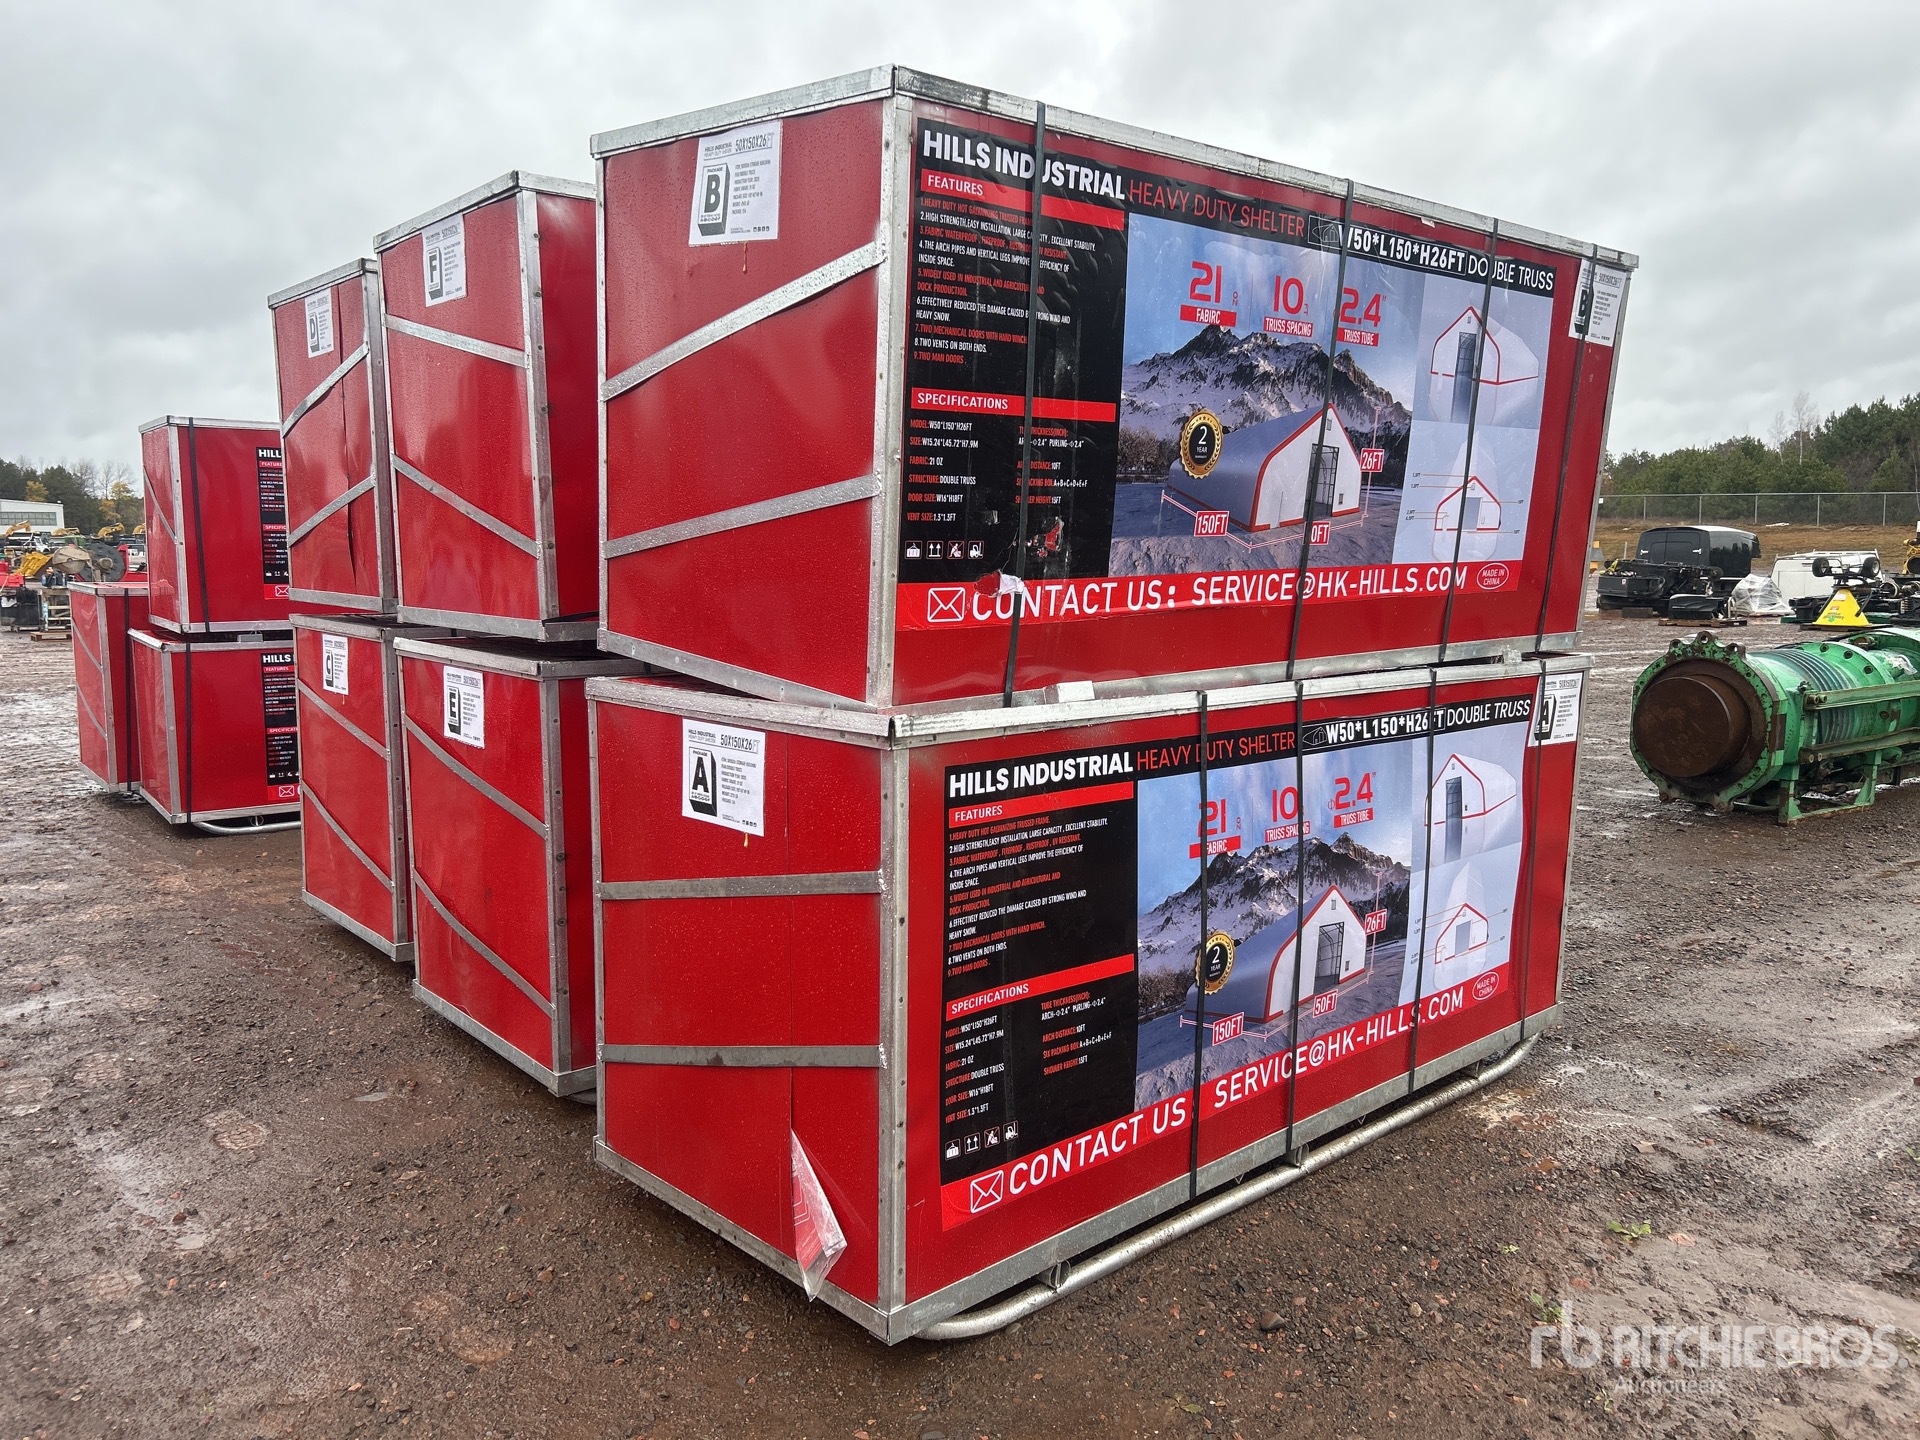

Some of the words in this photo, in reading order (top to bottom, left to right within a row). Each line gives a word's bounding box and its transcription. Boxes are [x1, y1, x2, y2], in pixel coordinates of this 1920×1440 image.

[704, 174, 721, 213] B
[928, 174, 983, 196] FEATURES
[923, 130, 991, 169] HILLS
[1129, 179, 1189, 212] HEAVY
[1194, 194, 1237, 222] DUTY
[1240, 205, 1305, 237] SHELTER
[1518, 265, 1554, 291] TRUSS
[920, 211, 938, 222] 2.HIGH
[1012, 228, 1026, 238] LARGE
[1052, 236, 1074, 248] EXCELLENT
[918, 254, 936, 263] INSIDE
[936, 242, 950, 252] ARCH
[951, 244, 966, 254] PIPES
[966, 247, 976, 256] AND
[978, 248, 998, 260] VERTICAL
[1000, 252, 1010, 262] LEGS
[1064, 264, 1070, 272] OF
[429, 254, 437, 284] F
[1189, 261, 1222, 303] 21
[1273, 275, 1304, 314] 10
[916, 310, 933, 320] HEAVY
[954, 300, 976, 311] REDUCED
[977, 304, 986, 312] THE
[987, 304, 1006, 316] DAMAGE
[1007, 307, 1024, 318] CAUSED
[1060, 316, 1070, 324] AND
[1196, 309, 1221, 324] FABIRC
[1266, 318, 1286, 334] TRUSS
[1286, 321, 1312, 336] SPACING
[1344, 329, 1360, 344] TRUSS
[1362, 332, 1374, 345] TUBE
[914, 338, 932, 347] 8.TWO
[932, 340, 949, 349] VENTS
[950, 341, 958, 350] ON
[958, 342, 972, 352] BOTH
[918, 392, 1008, 410] SPECIFICATIONS
[1198, 426, 1208, 444] 2
[258, 449, 282, 458] HILL
[936, 457, 944, 466] OZ
[1361, 452, 1384, 470] 26FT
[960, 476, 976, 484] TRUSS
[1198, 514, 1227, 534] 150FT
[1310, 523, 1328, 543] 0FT
[1482, 570, 1497, 578] MADE
[1498, 568, 1504, 576] IN
[1483, 578, 1500, 586] CHINA
[972, 582, 1118, 621] CONTACT
[1127, 580, 1175, 611] US:
[262, 654, 291, 664] HILLS
[326, 654, 331, 674] C
[449, 692, 457, 718] E
[950, 767, 1009, 798] HILLS
[1013, 751, 1134, 788] INDUSTRIAL
[1137, 746, 1191, 770] HEAVY
[1239, 731, 1295, 756] SHELTER
[1447, 703, 1491, 727] DOUBLE
[1494, 699, 1531, 719] TRUSS
[692, 756, 710, 794] A
[955, 805, 1003, 822] FEATURES
[1272, 786, 1298, 822] 10
[1065, 821, 1086, 832] EXCELLENT
[1197, 799, 1226, 838] 21
[1340, 811, 1358, 825] TRUSS
[1358, 808, 1370, 821] TUBE
[1266, 828, 1286, 842] TRUSS
[963, 866, 976, 876] ARCH
[976, 864, 988, 873] PIPES
[988, 862, 998, 870] AND
[998, 858, 1018, 868] VERTICAL
[1078, 844, 1084, 852] OF
[950, 880, 964, 890] INSIDE
[978, 909, 998, 920] REDUCED
[998, 906, 1006, 915] THE
[1006, 902, 1024, 913] DAMAGE
[1024, 898, 1042, 909] CAUSED
[1048, 894, 1066, 904] STRONG
[1078, 890, 1086, 898] AND
[1366, 912, 1386, 932] 26FT
[948, 930, 962, 940] HEAVY
[948, 954, 962, 966] 8.TWO
[963, 951, 976, 960] VENTS
[984, 944, 994, 954] BOTH
[1212, 946, 1220, 964] 2
[1476, 978, 1490, 990] MADE
[1491, 976, 1496, 985] IN
[1478, 986, 1492, 997] CHINA
[952, 983, 1029, 1014] SPECIFICATIONS
[1314, 992, 1337, 1014] 50FT
[1215, 1016, 1242, 1042] 150FT
[990, 1062, 1005, 1074] TRUSS
[1009, 1114, 1144, 1195] CONTACT
